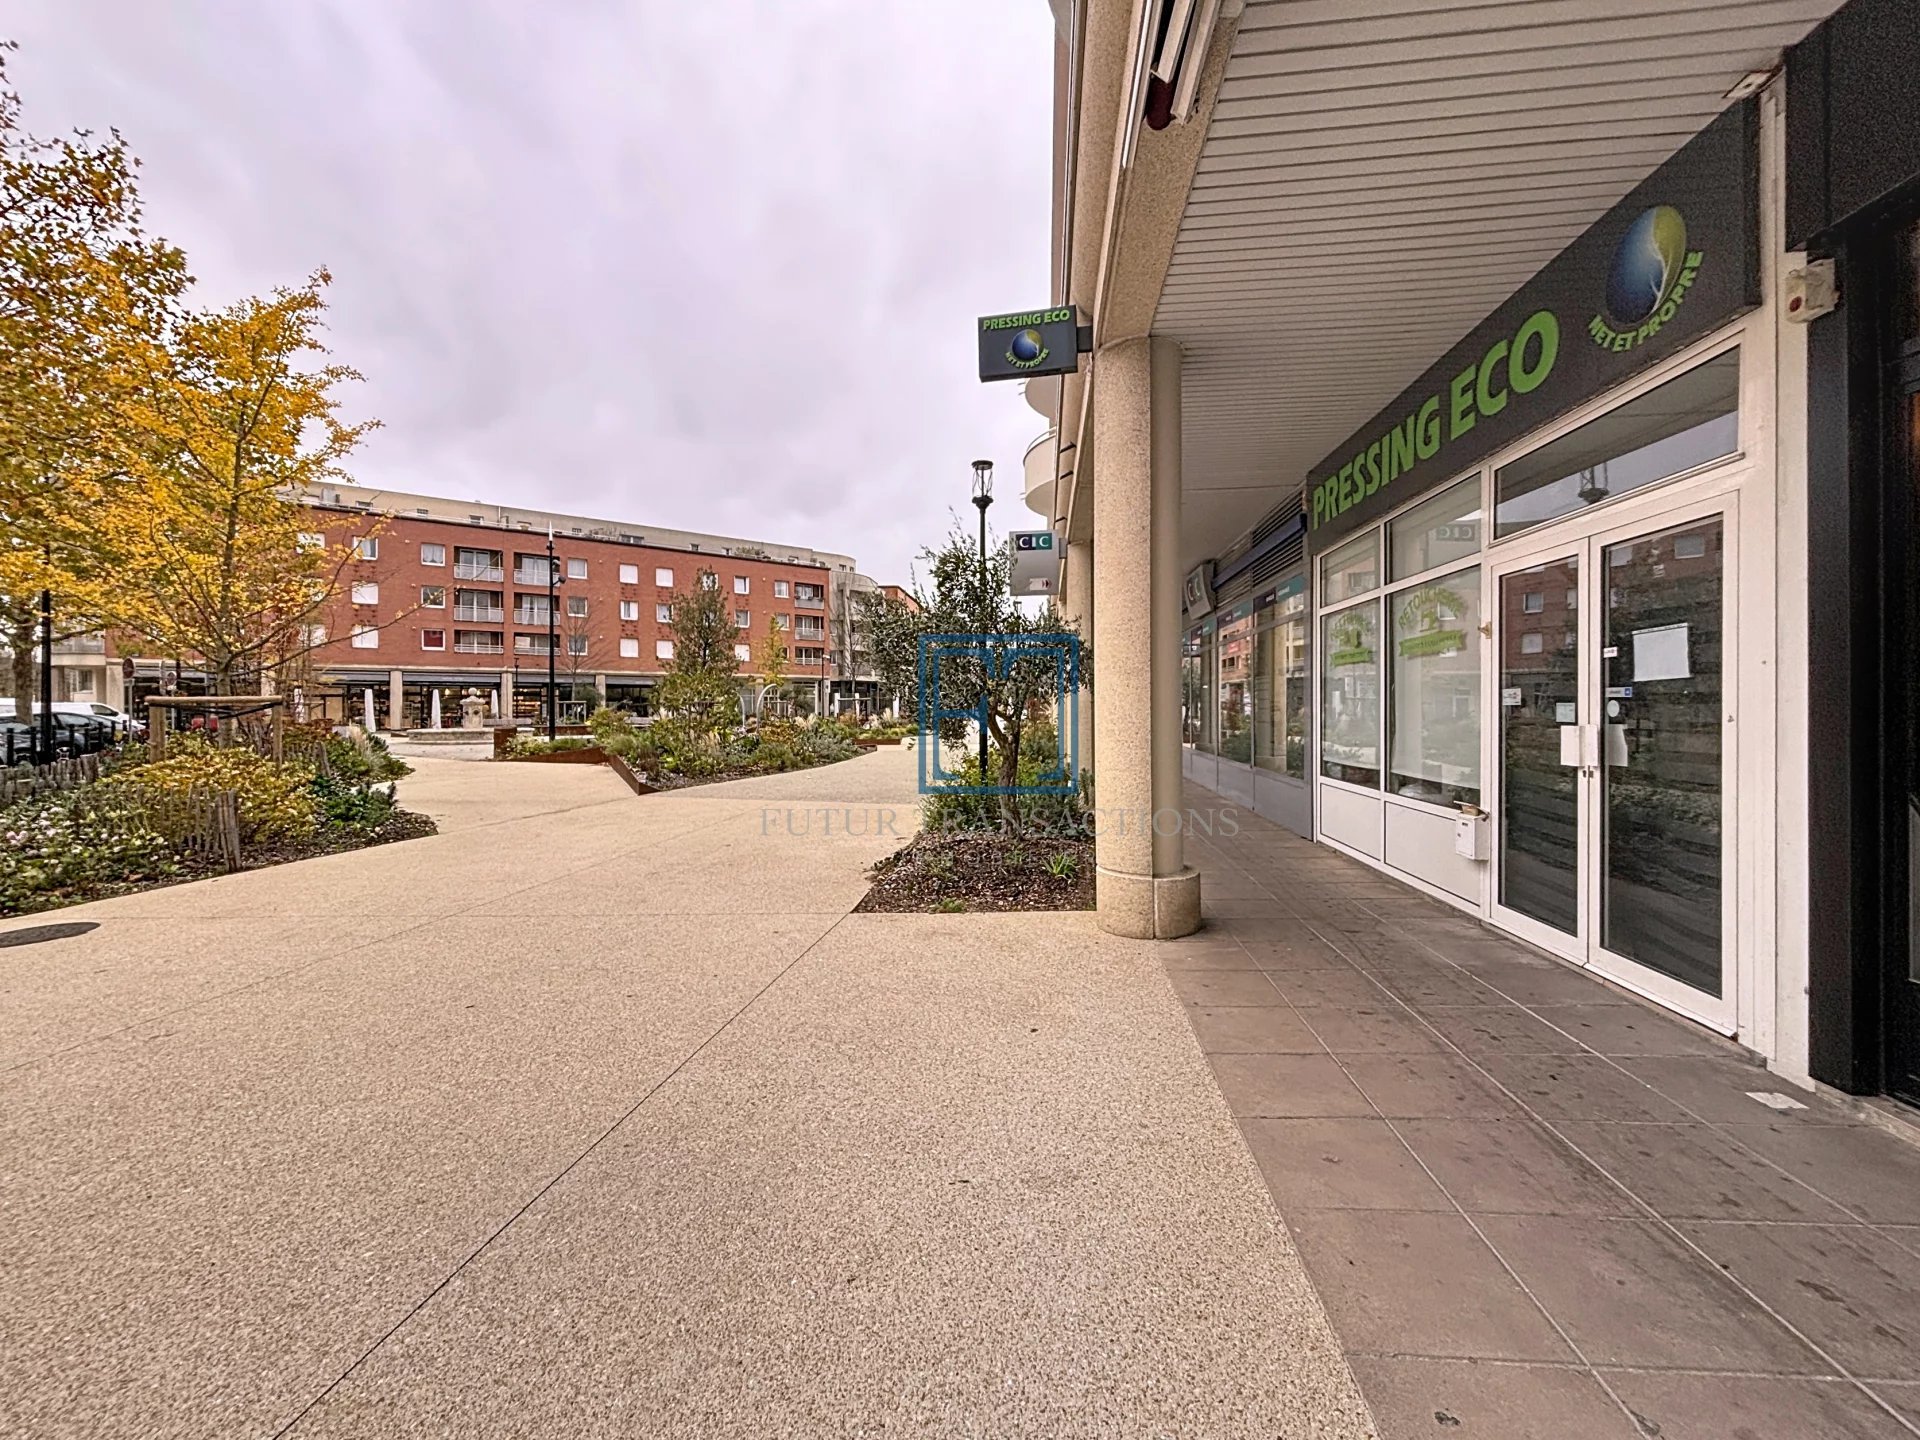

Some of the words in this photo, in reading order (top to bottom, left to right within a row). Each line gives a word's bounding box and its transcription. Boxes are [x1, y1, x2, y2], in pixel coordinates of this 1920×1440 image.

[1588, 314, 1616, 348] NET
[1612, 331, 1638, 353] ET
[1637, 251, 1704, 345] PROPRE
[983, 313, 1041, 330] PRESSING
[1044, 309, 1070, 323] ECO
[1005, 351, 1016, 365] NET
[1015, 360, 1025, 369] ET
[1025, 348, 1050, 369] PROPRE
[1313, 395, 1441, 530] PRESSING
[1450, 310, 1560, 441] ECO
[1018, 536, 1050, 549] CIC
